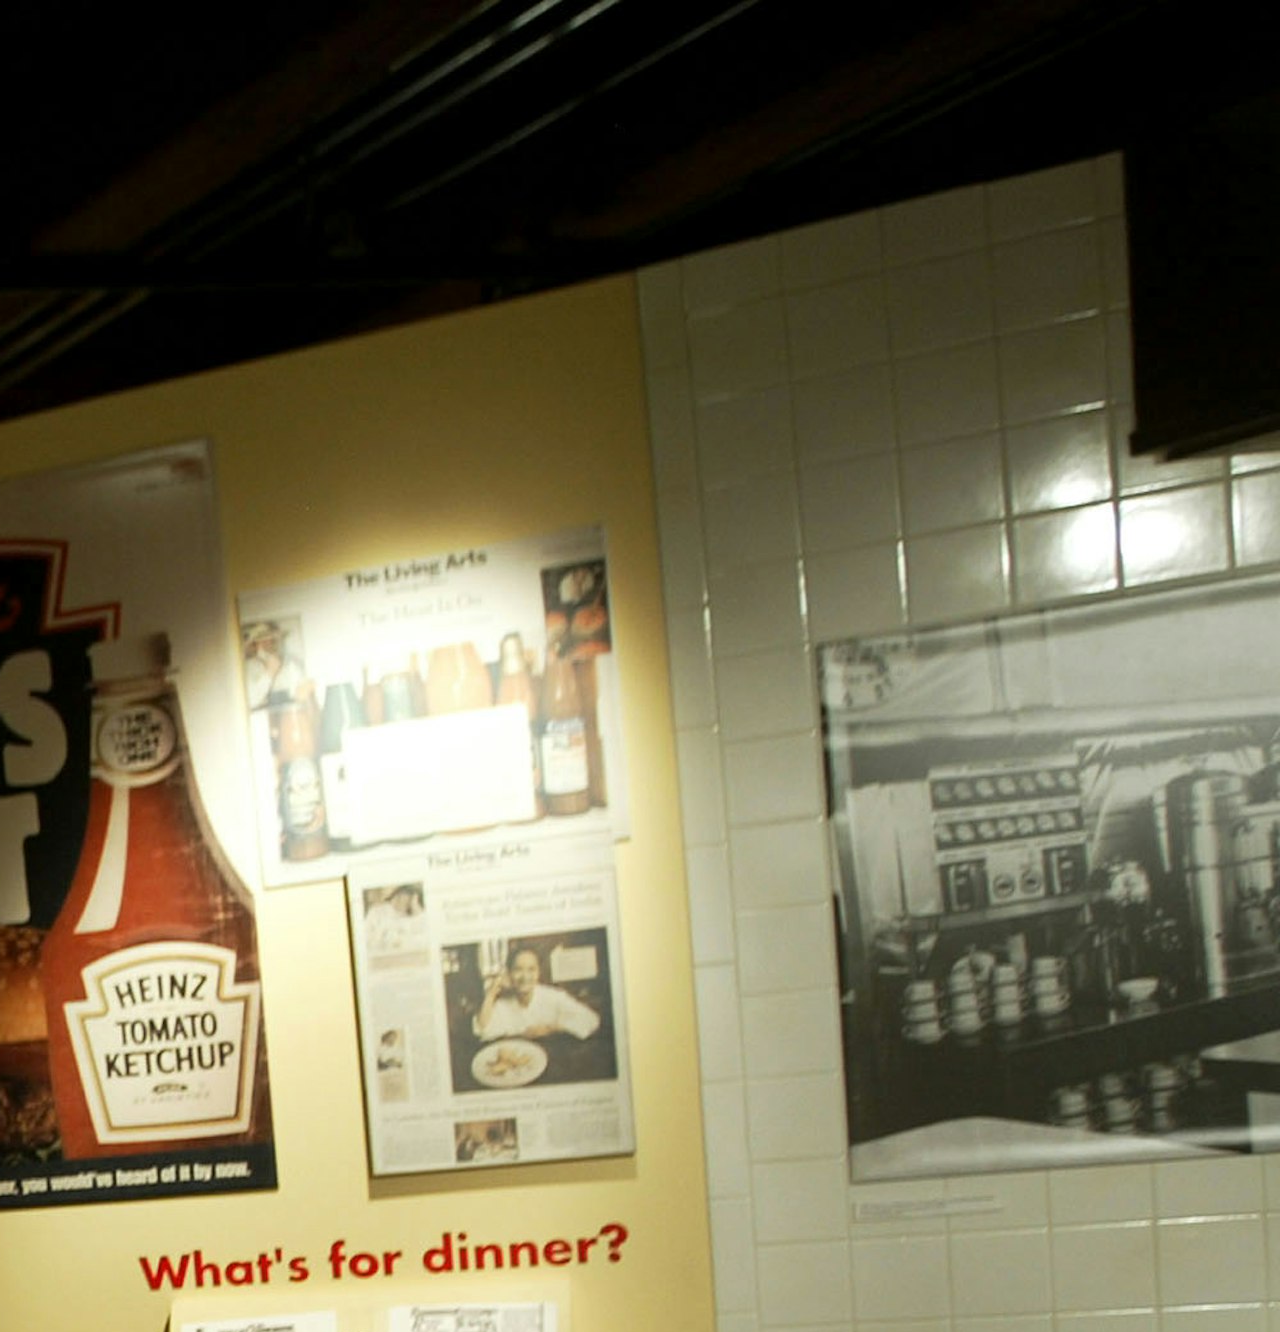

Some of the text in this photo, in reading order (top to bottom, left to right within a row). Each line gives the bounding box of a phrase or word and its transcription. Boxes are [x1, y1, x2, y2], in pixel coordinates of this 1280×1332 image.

[346, 573, 378, 592] The
[446, 549, 487, 571] Arts
[115, 974, 207, 1008] HEINZ
[116, 1012, 218, 1046] TOMATO
[105, 1041, 235, 1078] KETCHUP
[21, 1177, 48, 1196] you
[50, 1171, 114, 1192] would've
[116, 1167, 158, 1187] heard
[160, 1164, 176, 1183] of
[179, 1163, 191, 1182] it
[193, 1162, 212, 1181] by
[140, 1223, 629, 1291] What's for dinner?
